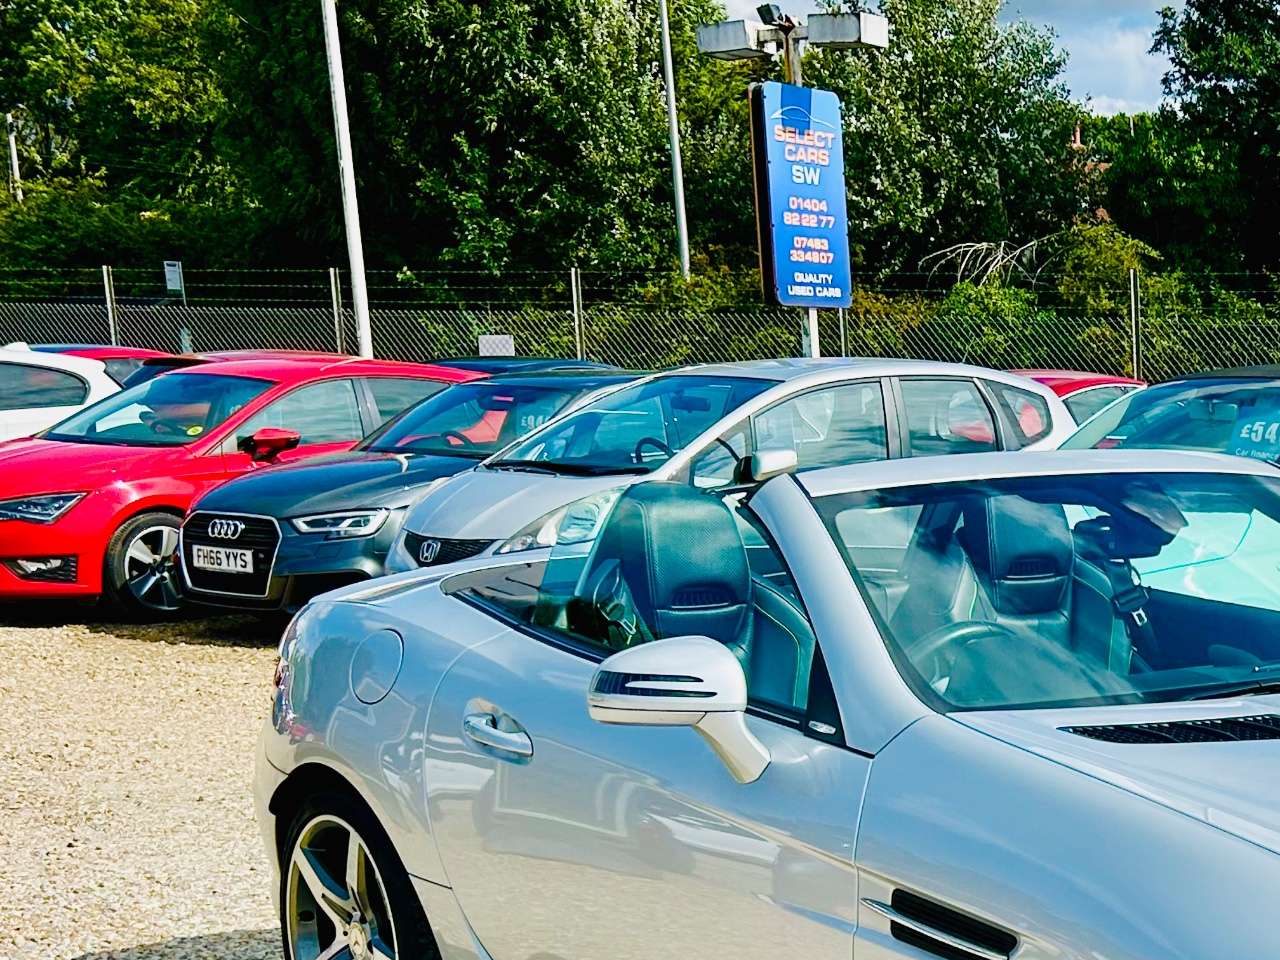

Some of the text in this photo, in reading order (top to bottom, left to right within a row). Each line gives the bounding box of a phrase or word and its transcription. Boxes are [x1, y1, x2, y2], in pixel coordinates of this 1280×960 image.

[774, 125, 834, 148] SELECT
[785, 144, 829, 166] CARS
[792, 165, 820, 185] SW
[789, 196, 827, 212] 01404
[819, 215, 835, 229] 77
[794, 272, 832, 285] QUALITY
[788, 285, 842, 297] USED CARS
[196, 548, 248, 569] FH66 YYS
